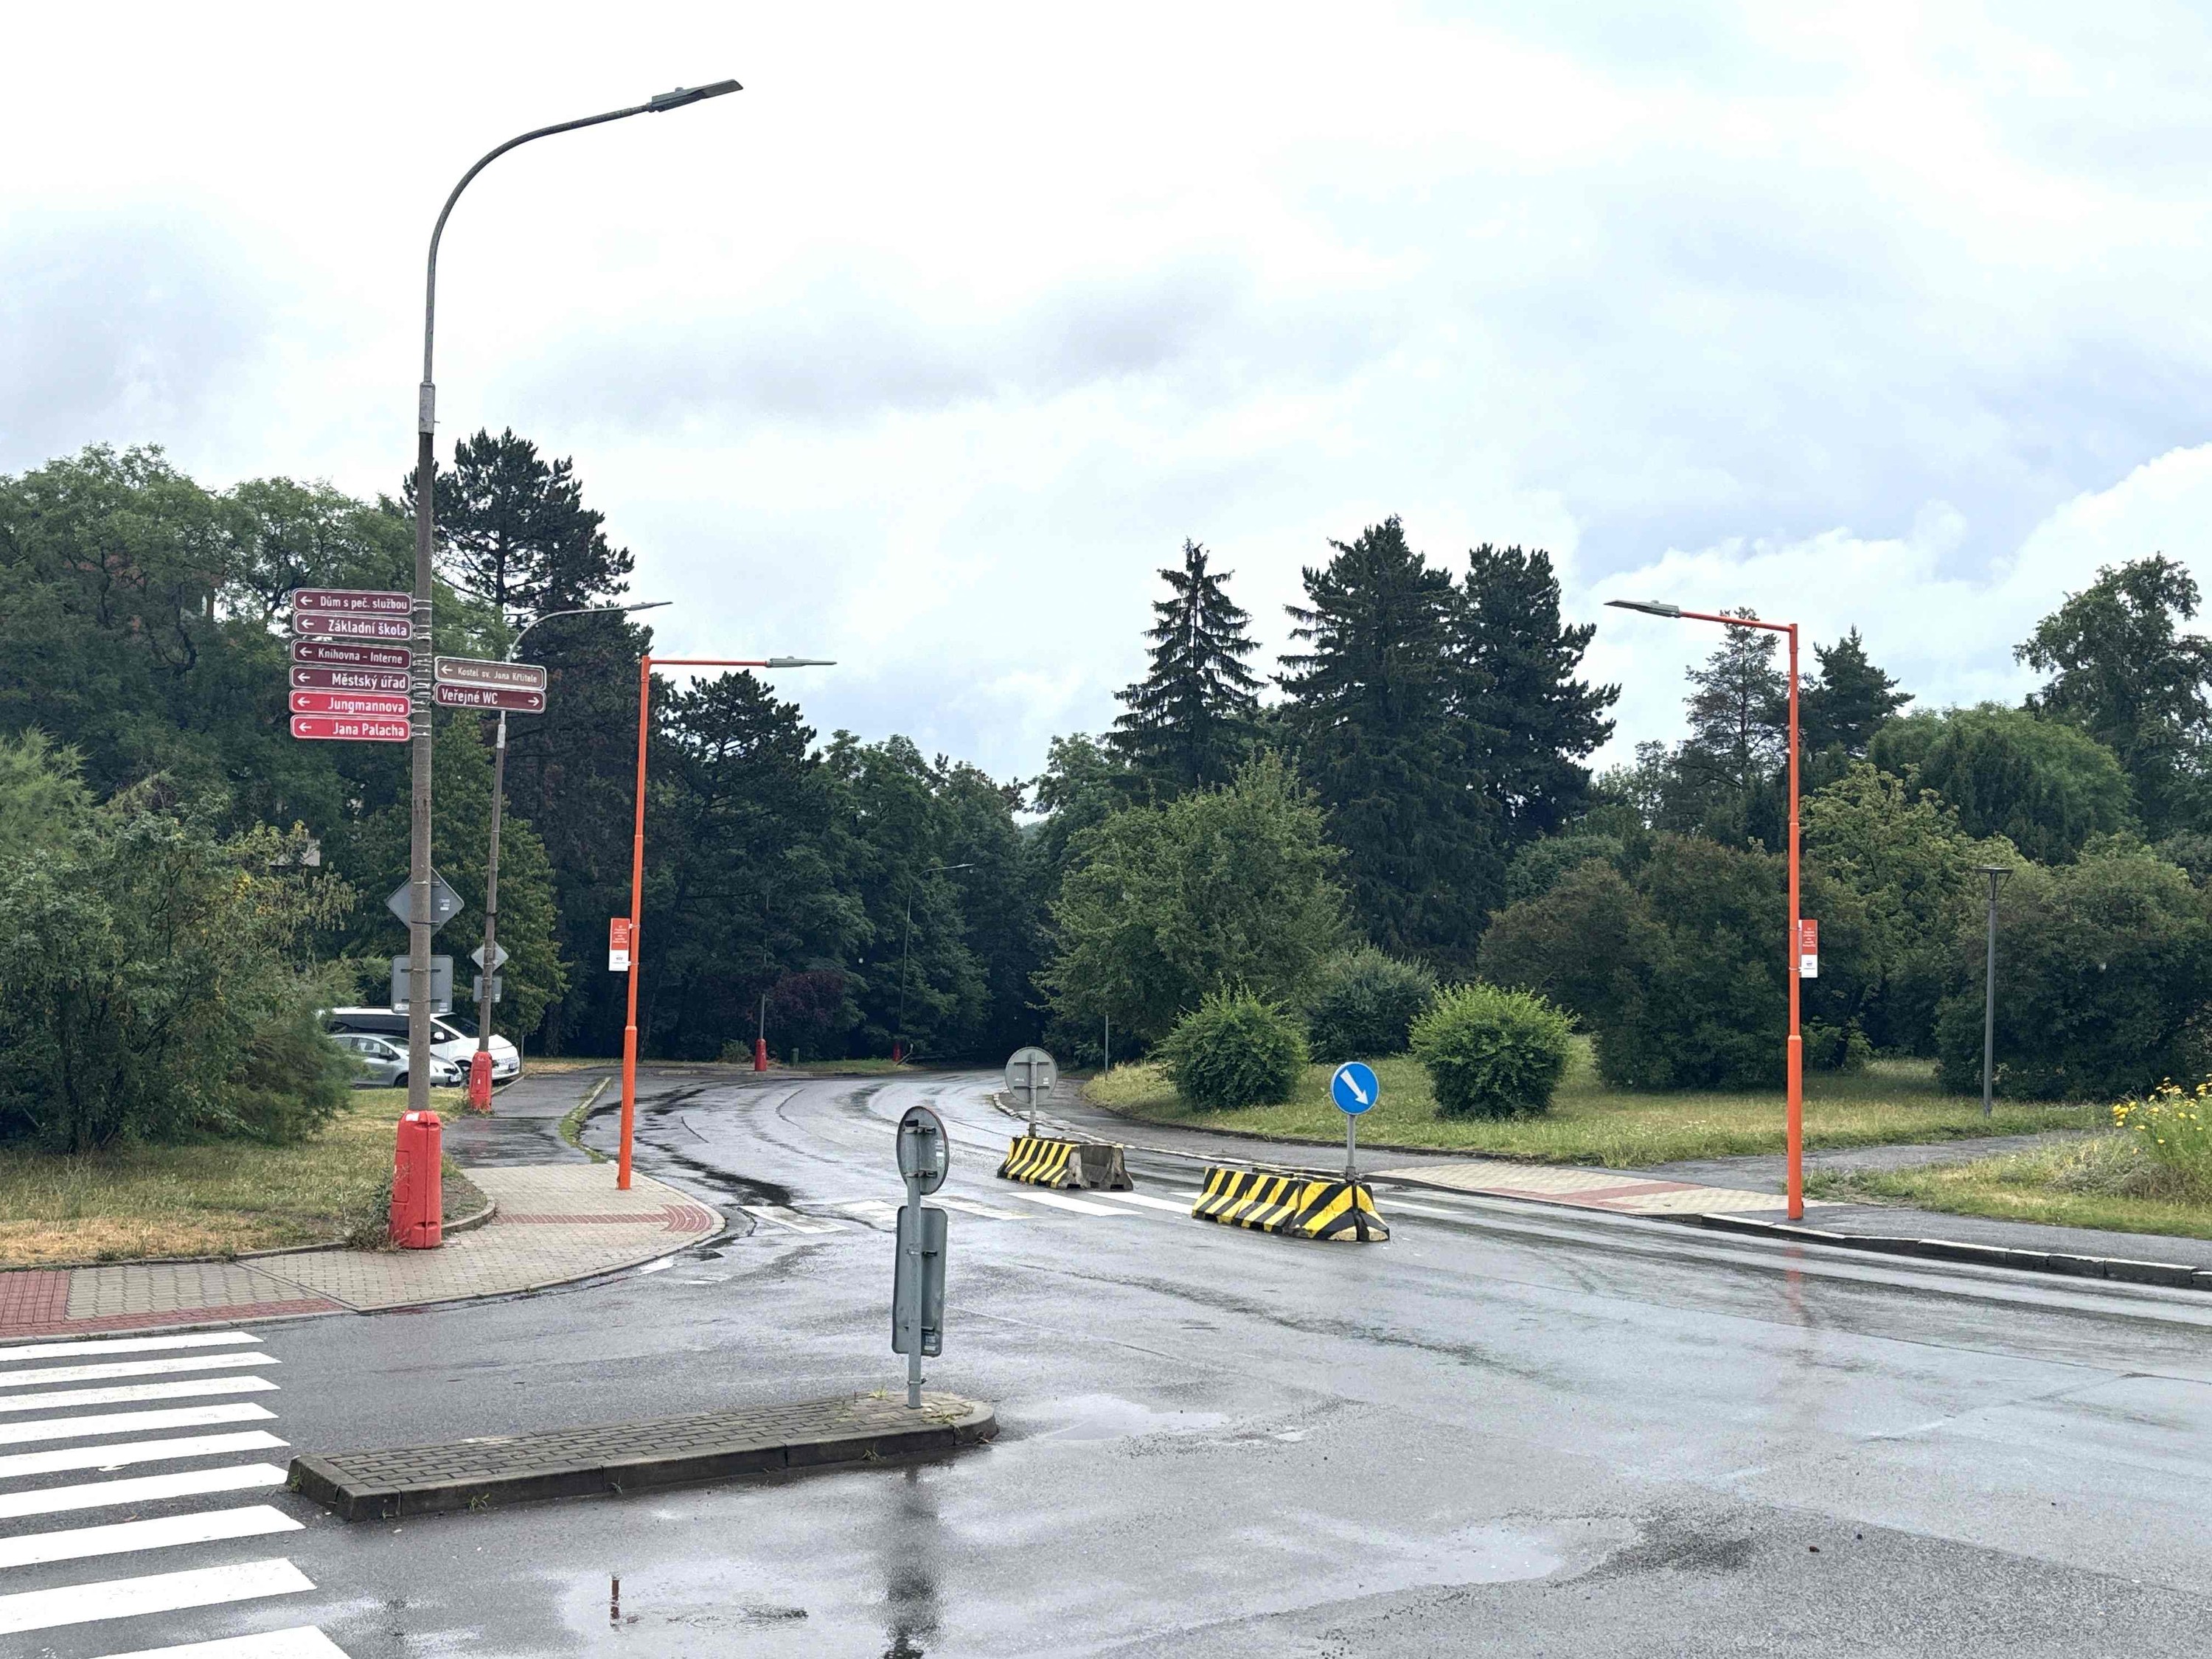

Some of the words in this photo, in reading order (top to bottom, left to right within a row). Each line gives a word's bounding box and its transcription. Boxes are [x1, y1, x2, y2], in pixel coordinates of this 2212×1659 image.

[320, 596, 341, 608] Dům
[351, 598, 369, 610] peč.
[372, 598, 407, 610] službou
[328, 619, 375, 635] Základní
[378, 623, 407, 636] škola
[318, 647, 360, 661] Knihovna
[370, 651, 403, 664] Interne
[332, 672, 378, 690] Městský
[380, 675, 406, 689] úřad
[458, 667, 479, 678] Kostel
[494, 671, 509, 680] Jana
[442, 687, 479, 705] Veřejné
[483, 692, 498, 704] WC
[328, 697, 405, 713] Jungmannova
[333, 722, 359, 735] Jana
[362, 723, 405, 737] Palacha
